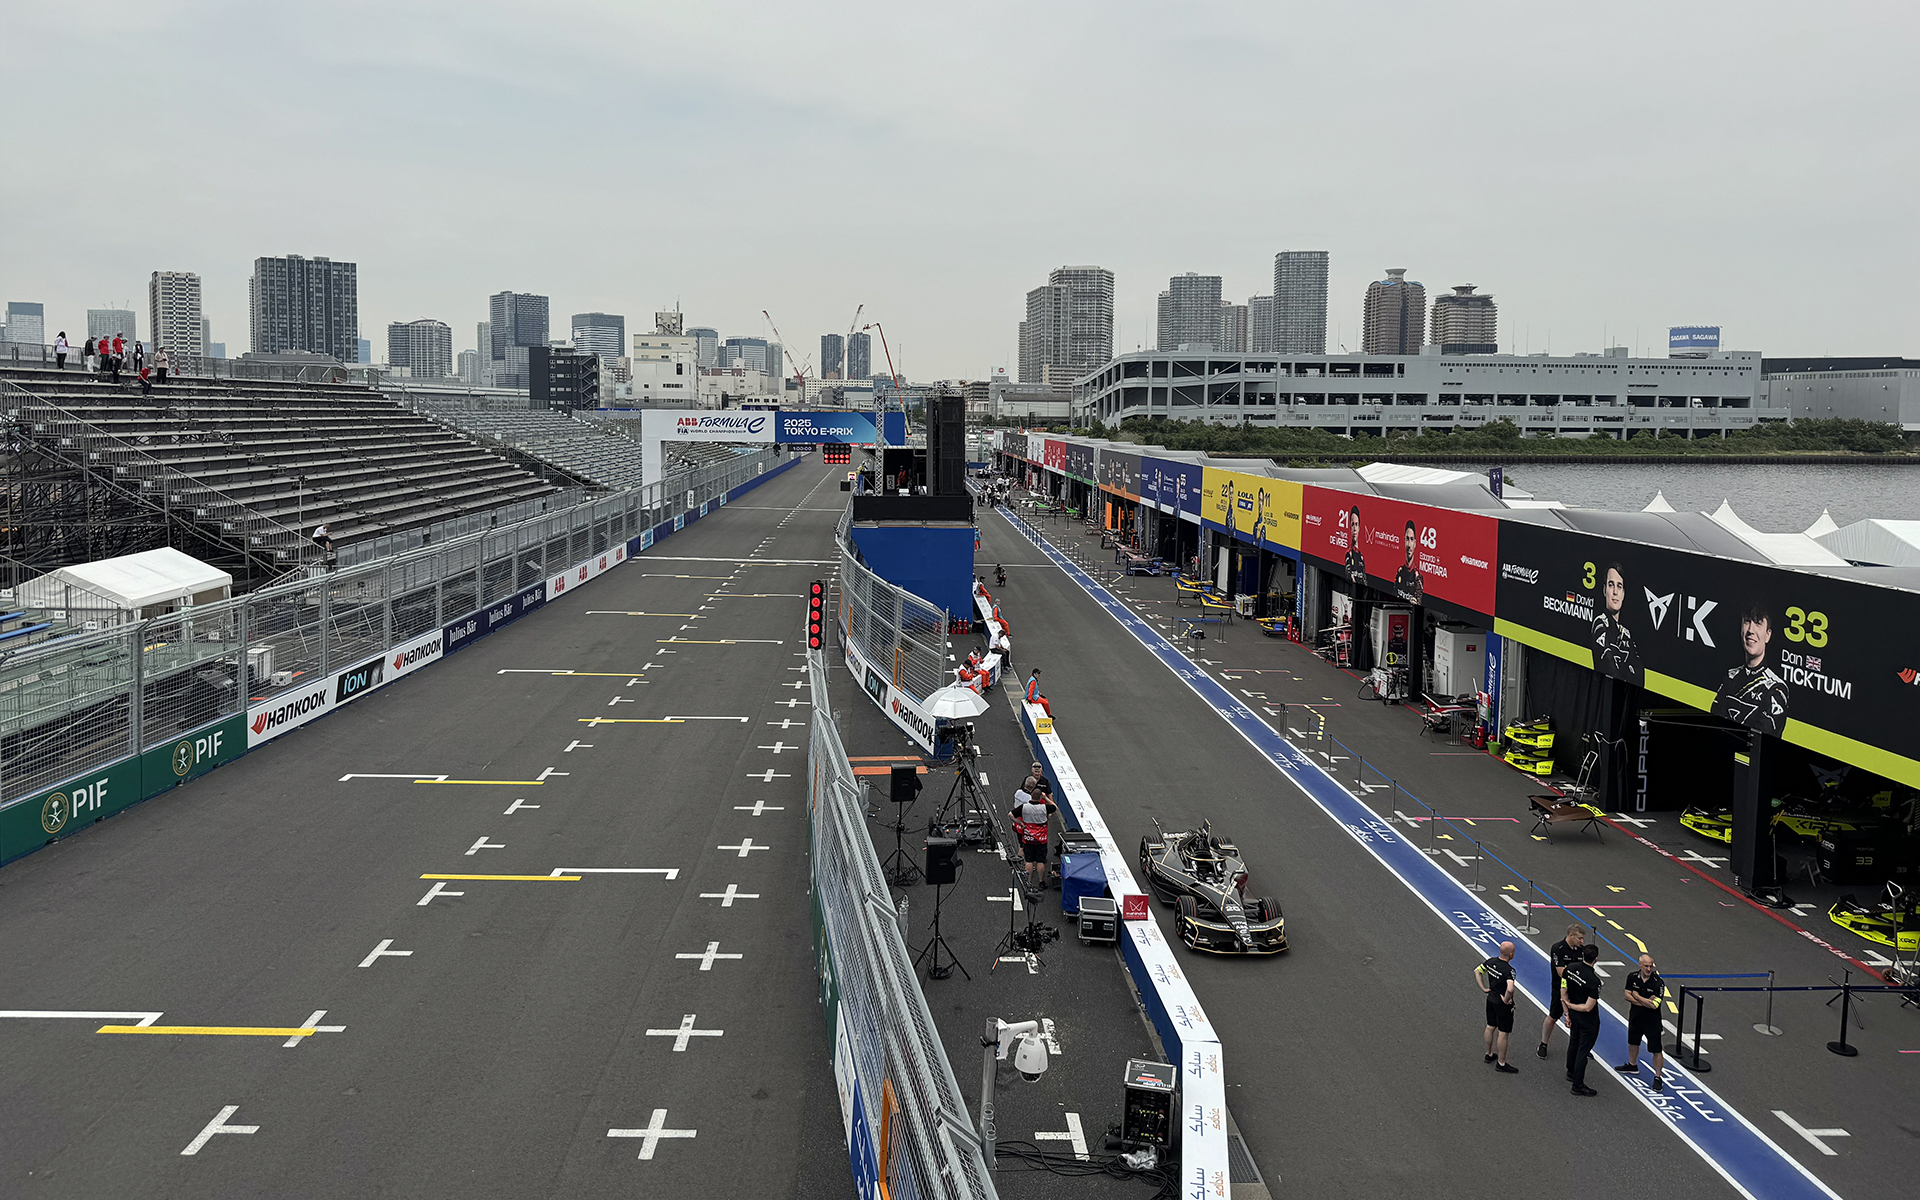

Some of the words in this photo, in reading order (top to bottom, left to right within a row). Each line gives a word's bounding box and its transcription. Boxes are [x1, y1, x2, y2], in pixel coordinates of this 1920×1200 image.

[677, 417, 698, 426] ABB
[699, 416, 749, 428] FORMULA
[784, 419, 812, 427] 2025
[784, 427, 818, 436] TOKYO
[820, 427, 853, 436] E-PRIX
[1221, 484, 1228, 498] 22
[1237, 490, 1254, 500] LOLA
[1265, 493, 1271, 508] 11
[1338, 509, 1349, 528] 21
[1329, 535, 1336, 545] DE
[1375, 531, 1400, 544] mahindra
[1420, 526, 1437, 550] 48
[599, 556, 607, 572] ABB
[1419, 561, 1448, 579] MORTARA
[579, 565, 588, 582] ABB
[1582, 561, 1597, 590] 3
[554, 576, 565, 594] ABB
[522, 593, 535, 611] Julius
[534, 588, 543, 601] Bär
[1543, 595, 1594, 622] BECKMANN
[1576, 593, 1594, 608] David
[488, 608, 503, 628] Julius
[503, 603, 514, 617] Bär
[449, 626, 466, 647] Julius
[466, 620, 478, 636] Bär
[1783, 606, 1829, 649] 33
[1781, 649, 1803, 667] Dan
[1781, 663, 1852, 701] TICKTUM
[267, 688, 327, 730] HANKOOK
[195, 730, 223, 764] PIF
[72, 778, 109, 818] PIF
[1823, 859, 1831, 869] 3
[1856, 856, 1873, 866] 33
[1206, 1054, 1218, 1074] sabic
[1624, 1075, 1686, 1122] sabic
[1207, 1107, 1221, 1131] sabic
[1209, 1171, 1225, 1198] sabic
